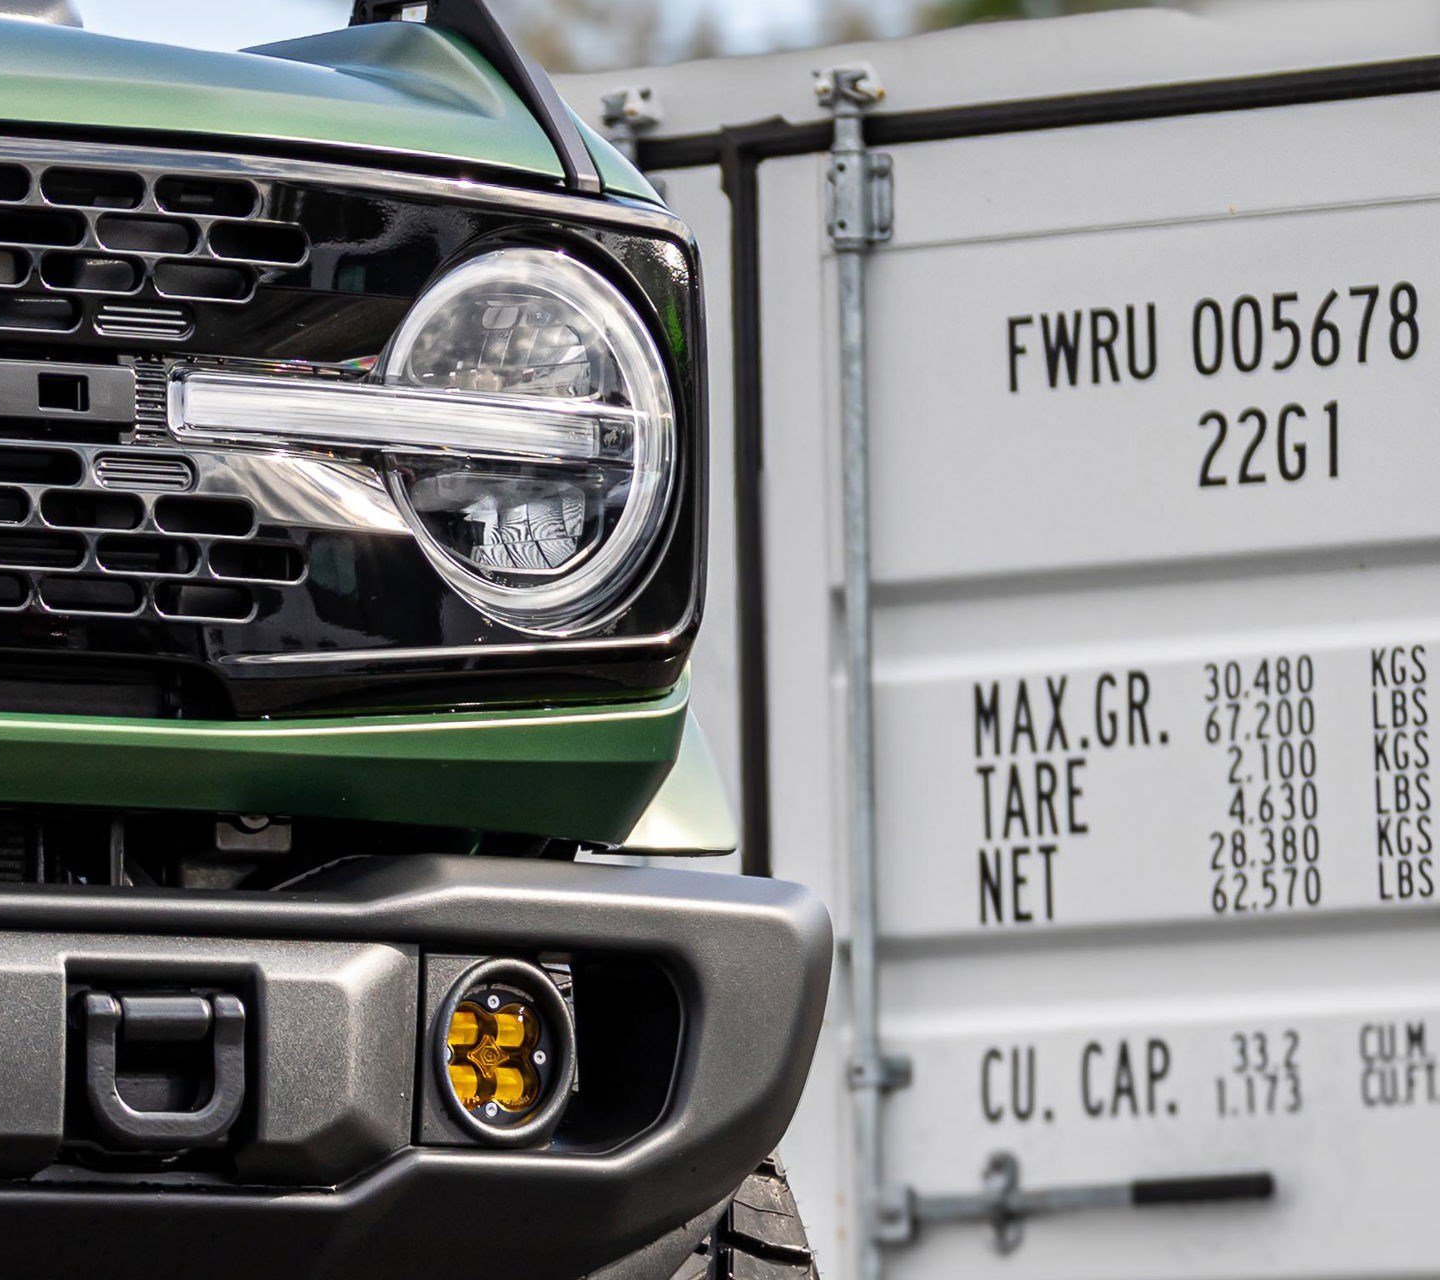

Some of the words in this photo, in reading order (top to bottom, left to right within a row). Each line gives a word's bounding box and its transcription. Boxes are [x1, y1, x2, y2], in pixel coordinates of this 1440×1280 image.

[1007, 302, 1158, 394] FWRU
[1191, 280, 1420, 377] 005678
[1198, 399, 1339, 488] 22G1
[973, 670, 1170, 758] MAX.GR.
[1205, 654, 1315, 703] 30.480
[1371, 644, 1427, 688] KGS
[1205, 695, 1316, 746] 67.200
[1372, 686, 1429, 731] LBS
[976, 758, 1089, 841] TARE
[1228, 737, 1317, 785] 2.100
[1373, 728, 1431, 773] KGS
[1228, 780, 1318, 826] 4.630
[1375, 770, 1432, 816] LBS
[979, 844, 1058, 925] NET
[1210, 823, 1320, 872] 28.380
[1376, 813, 1434, 858] KGS
[1211, 866, 1322, 915] 62.570
[1378, 856, 1436, 901] LBS
[981, 1046, 1054, 1124] CU.
[1081, 1039, 1178, 1118] CAP.
[1233, 1029, 1302, 1074] 33.2
[1216, 1070, 1303, 1116] 1.173
